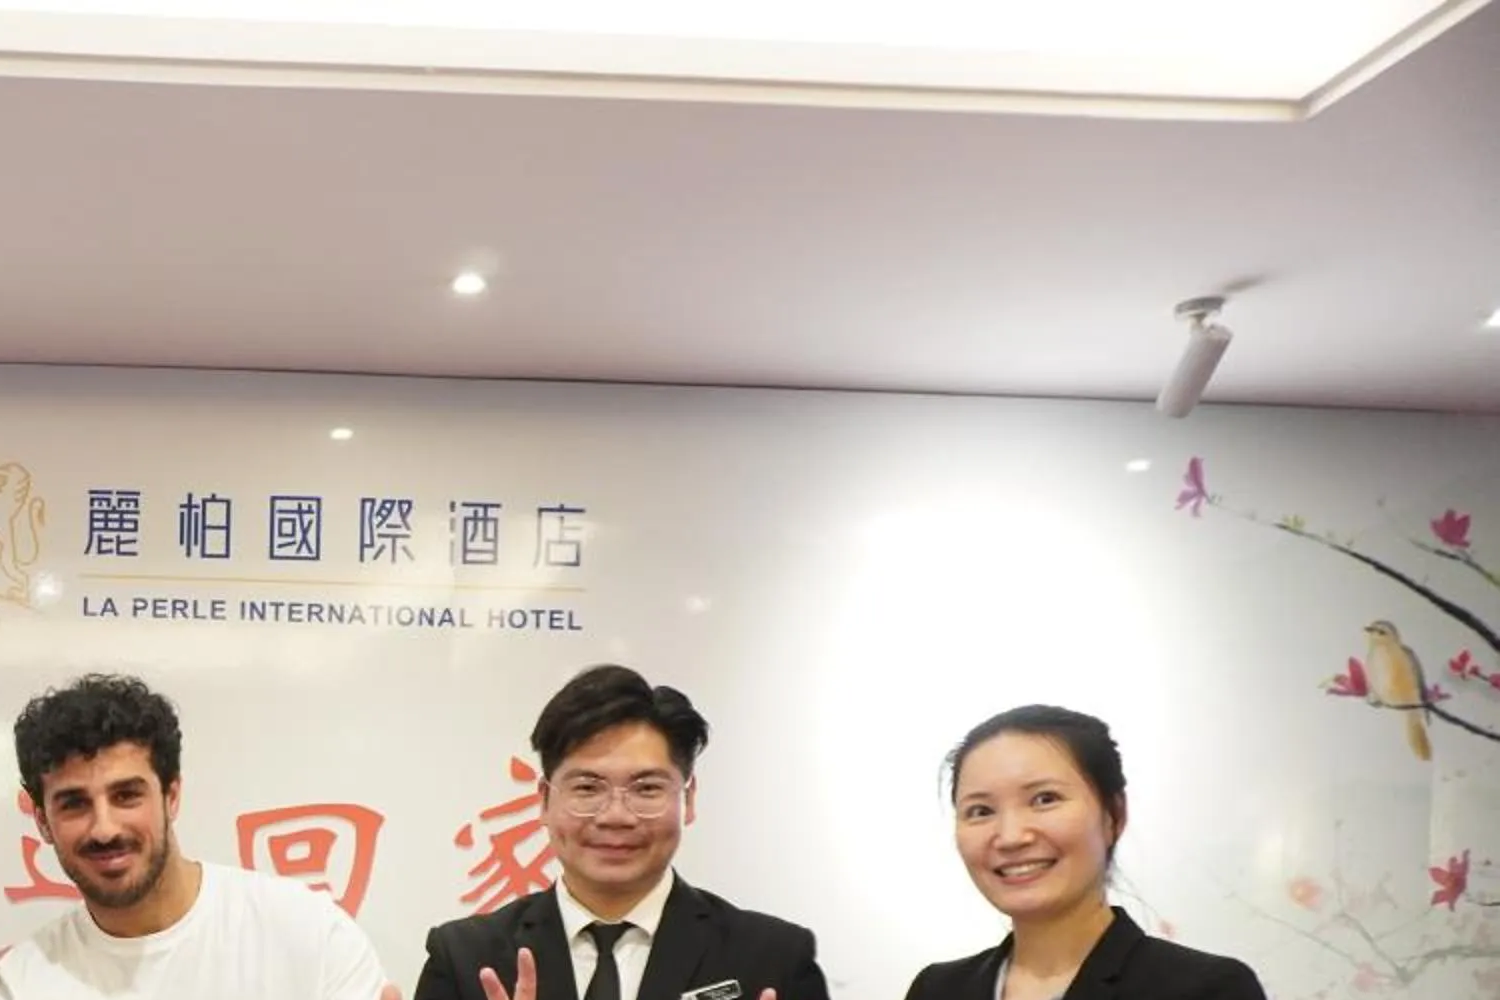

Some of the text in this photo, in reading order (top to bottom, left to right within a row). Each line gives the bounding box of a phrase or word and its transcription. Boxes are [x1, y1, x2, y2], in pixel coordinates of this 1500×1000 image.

[83, 488, 587, 570] 麗柏國際酒店
[82, 595, 583, 631] LA PERLE INTERNATIONAL HOTEL
